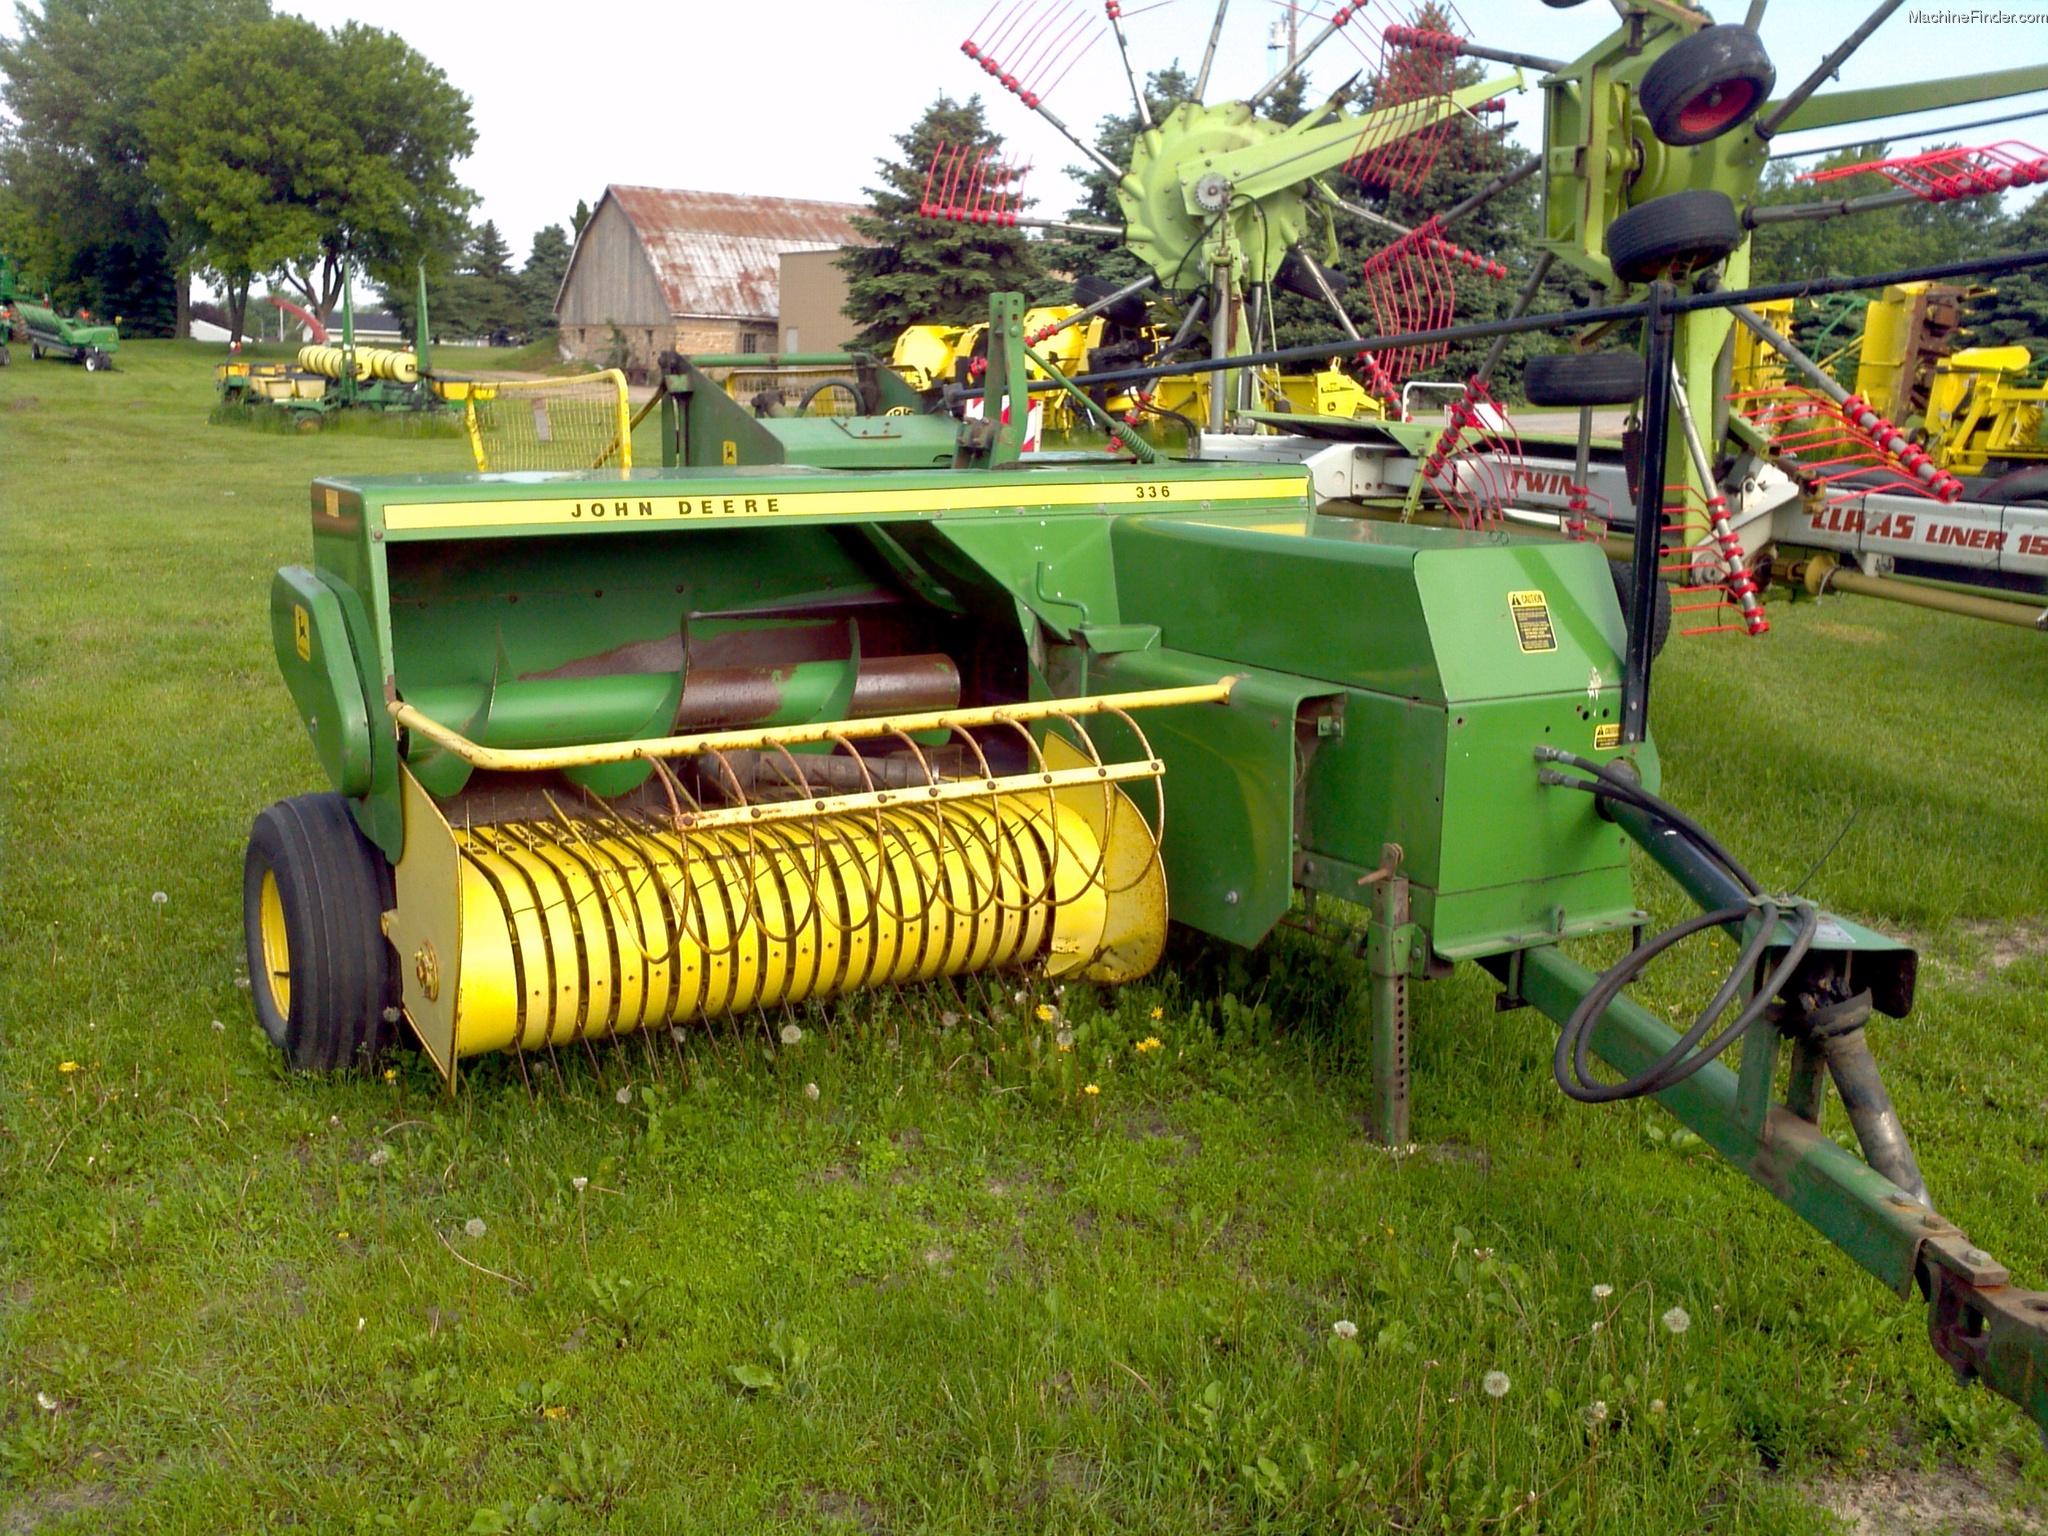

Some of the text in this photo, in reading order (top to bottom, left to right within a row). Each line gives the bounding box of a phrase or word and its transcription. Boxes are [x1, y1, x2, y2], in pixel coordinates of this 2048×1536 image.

[1136, 485, 1170, 498] 336
[1510, 470, 1574, 496] TWIN
[571, 498, 779, 518] JOHN DEERE
[1811, 506, 1916, 540] CLAAS
[1925, 523, 2009, 552] LINER
[1520, 593, 1543, 604] CAUTION
